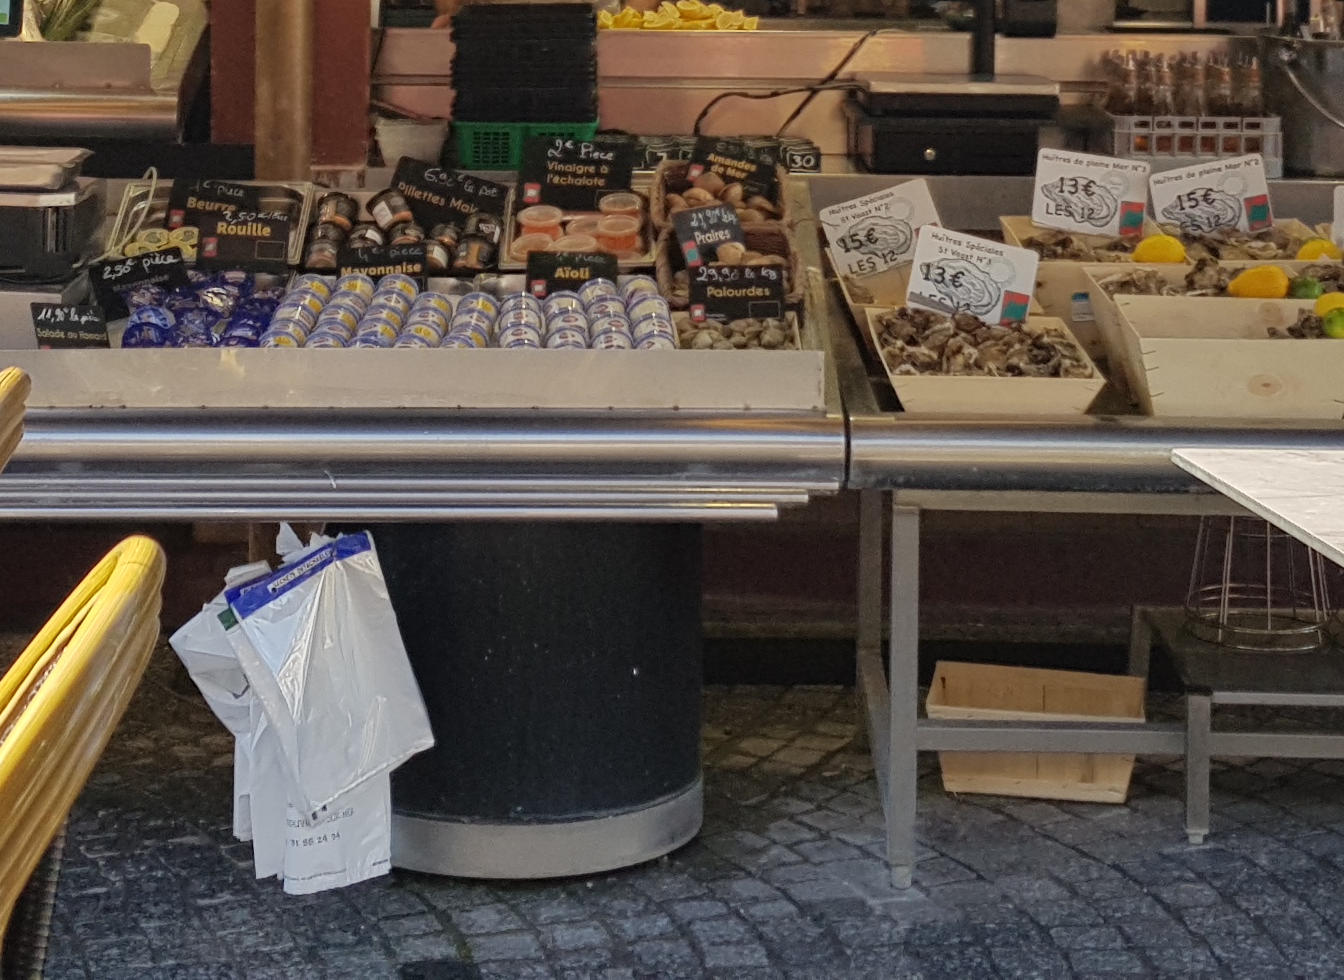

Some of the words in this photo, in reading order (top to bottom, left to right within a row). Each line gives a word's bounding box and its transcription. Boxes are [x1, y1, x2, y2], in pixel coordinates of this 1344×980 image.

[546, 161, 596, 175] Vinaigre
[600, 162, 609, 173] à
[707, 153, 757, 172] Amandes
[791, 154, 815, 169] 30
[1042, 153, 1071, 164] Huîtres
[1112, 162, 1129, 170] Mer
[711, 164, 725, 174] de
[727, 168, 748, 179] Mer
[1153, 175, 1183, 186] Huîtres
[1185, 171, 1196, 179] de
[1199, 167, 1222, 178] pleine
[1058, 176, 1079, 195] 13
[1082, 180, 1097, 197] €
[186, 196, 237, 213] Beurre
[1176, 190, 1200, 212] 15
[1202, 188, 1216, 206] €
[1045, 202, 1073, 217] LES
[1080, 207, 1095, 219] 12
[217, 221, 272, 237] Rouille
[694, 229, 731, 245] Praires
[839, 232, 863, 254] 15
[863, 227, 879, 245] €
[931, 232, 962, 247] Huîtres
[965, 241, 1004, 257] Spéciales
[938, 246, 948, 255] St
[340, 262, 422, 277] Mayonnaise
[847, 256, 876, 275] LES
[881, 250, 898, 265] 12
[554, 266, 591, 279] Aïoli
[923, 262, 946, 284] 13
[948, 270, 966, 289] €
[706, 286, 770, 298] Palourdes
[37, 327, 65, 339] Salade
